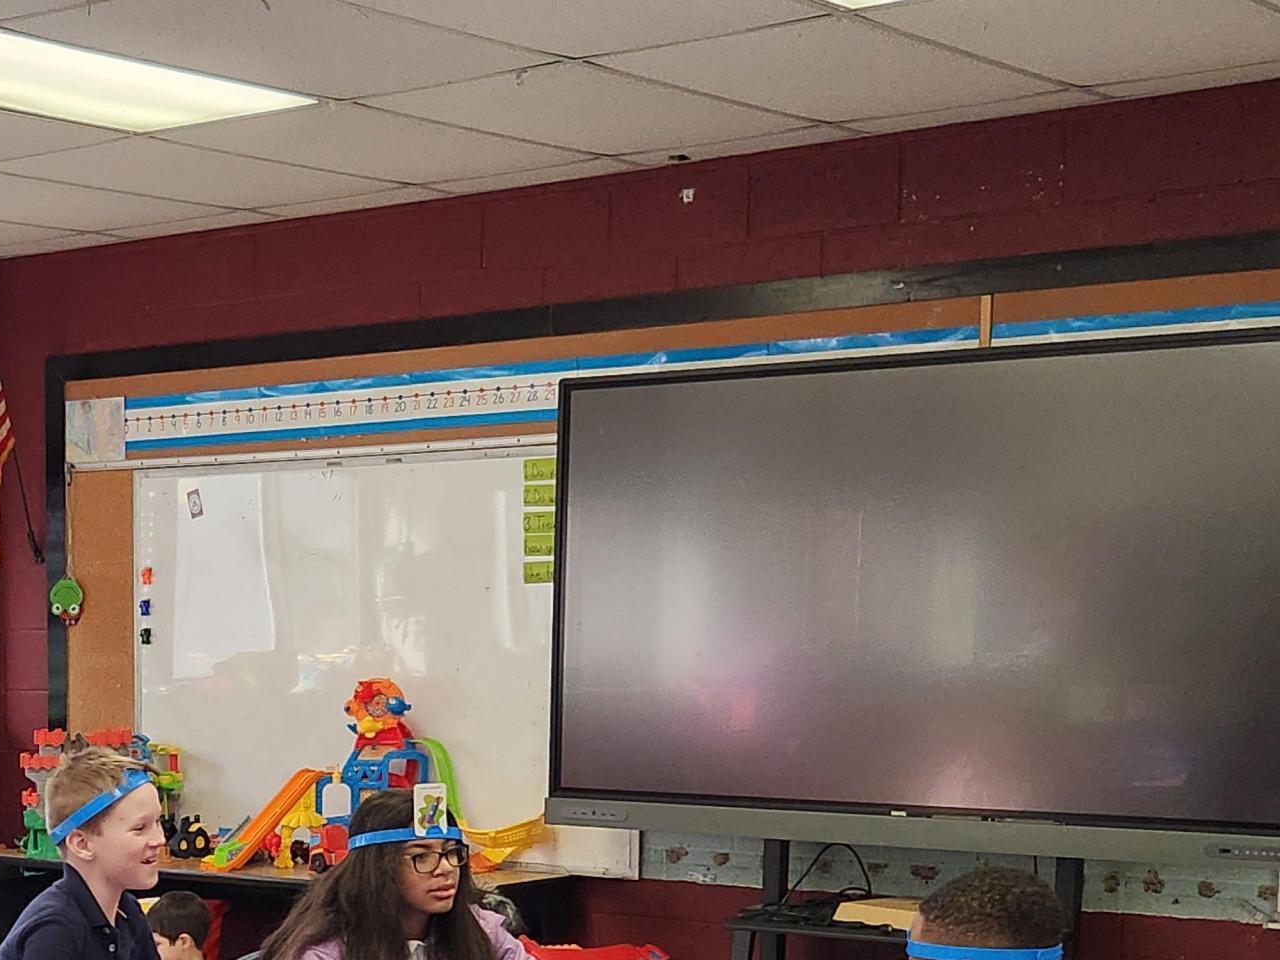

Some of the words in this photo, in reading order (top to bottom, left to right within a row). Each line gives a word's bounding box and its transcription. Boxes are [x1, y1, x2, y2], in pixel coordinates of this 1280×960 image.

[147, 421, 152, 432] 2
[160, 421, 165, 431] 3
[171, 420, 177, 430] 4
[183, 419, 189, 429] 5
[196, 418, 201, 428] 6
[209, 417, 214, 427] 7
[222, 416, 227, 426] 8
[235, 414, 240, 424] 9
[246, 413, 255, 424] 10
[261, 412, 268, 422] 11
[275, 411, 282, 422] 12
[290, 410, 298, 420] 13
[304, 409, 312, 420] 14
[318, 408, 327, 418] 15
[333, 407, 342, 417] 16
[349, 405, 358, 416] 17
[365, 404, 374, 415] 18
[381, 403, 389, 413] 19
[394, 401, 406, 413] 20
[413, 400, 421, 410] 21
[426, 398, 438, 409] 22
[443, 396, 455, 408] 23
[459, 395, 471, 407] 24
[476, 394, 488, 406] 25
[492, 393, 505, 405] 26
[510, 391, 521, 403] 27
[527, 390, 538, 402] 28
[544, 389, 556, 401] 29
